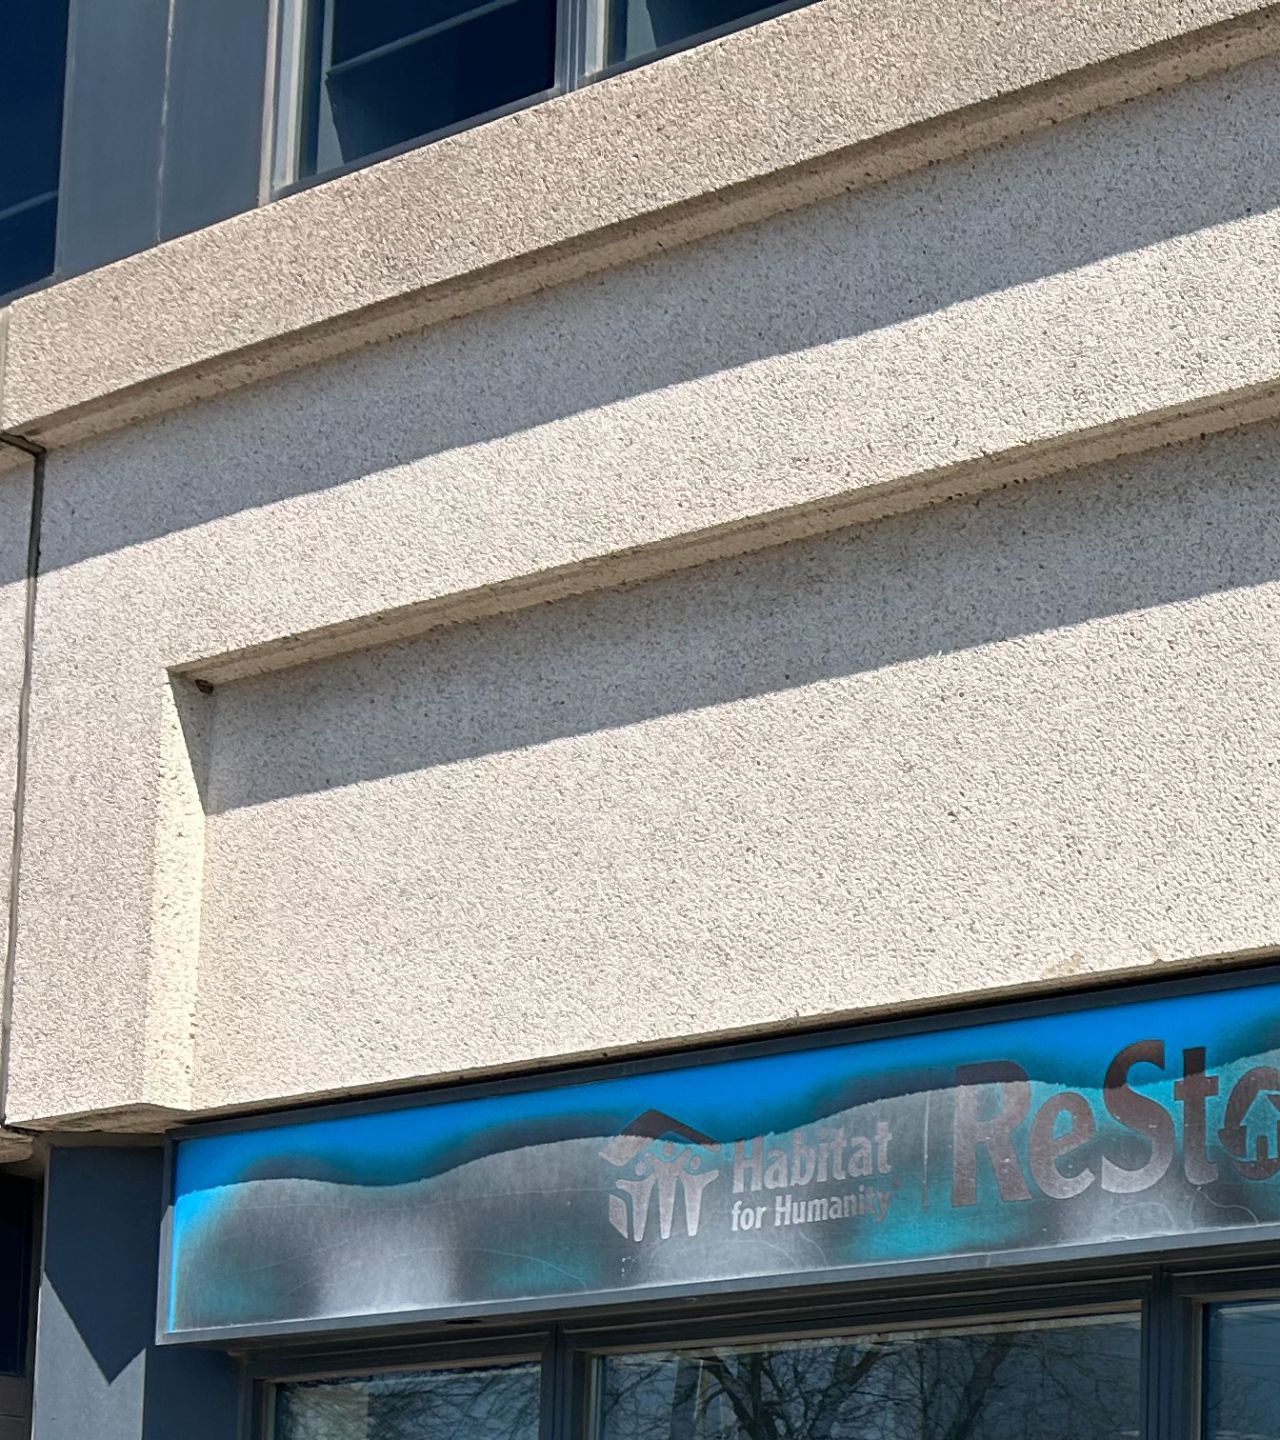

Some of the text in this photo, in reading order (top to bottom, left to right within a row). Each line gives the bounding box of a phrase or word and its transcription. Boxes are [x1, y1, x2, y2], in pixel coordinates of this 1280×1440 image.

[732, 1121, 893, 1194] Habitat
[731, 1185, 892, 1232] for Humanity
